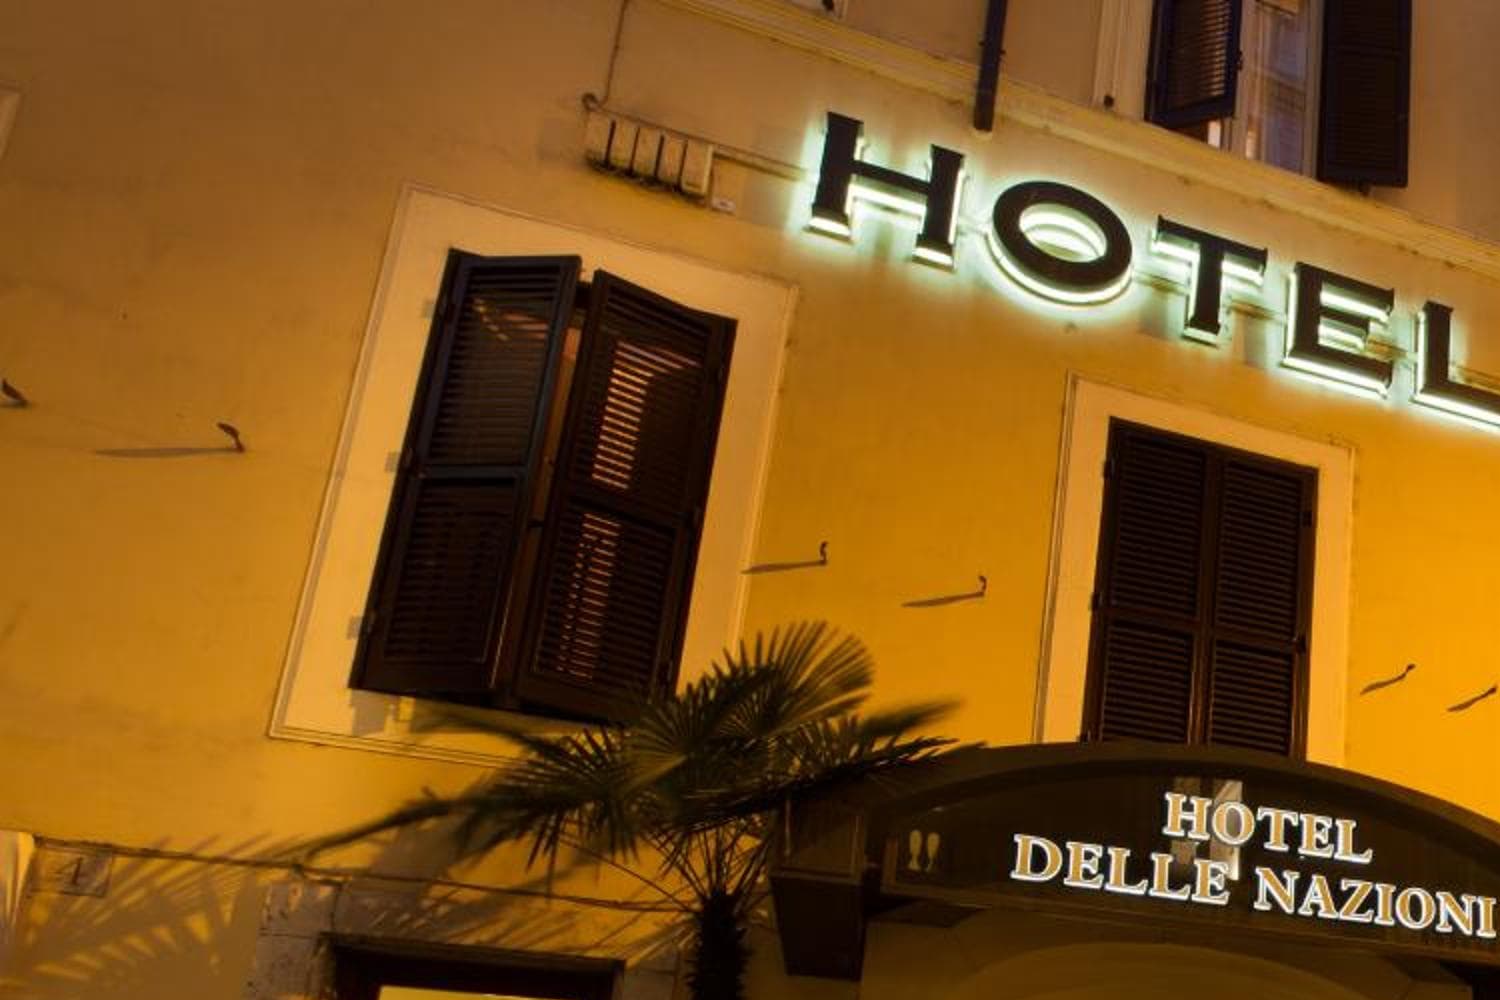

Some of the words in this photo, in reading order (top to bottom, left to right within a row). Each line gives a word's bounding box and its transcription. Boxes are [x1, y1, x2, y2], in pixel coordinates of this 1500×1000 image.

[1164, 791, 1373, 864] HOTEL
[1011, 834, 1230, 904] DELLE
[1254, 867, 1497, 938] NAZIONI
